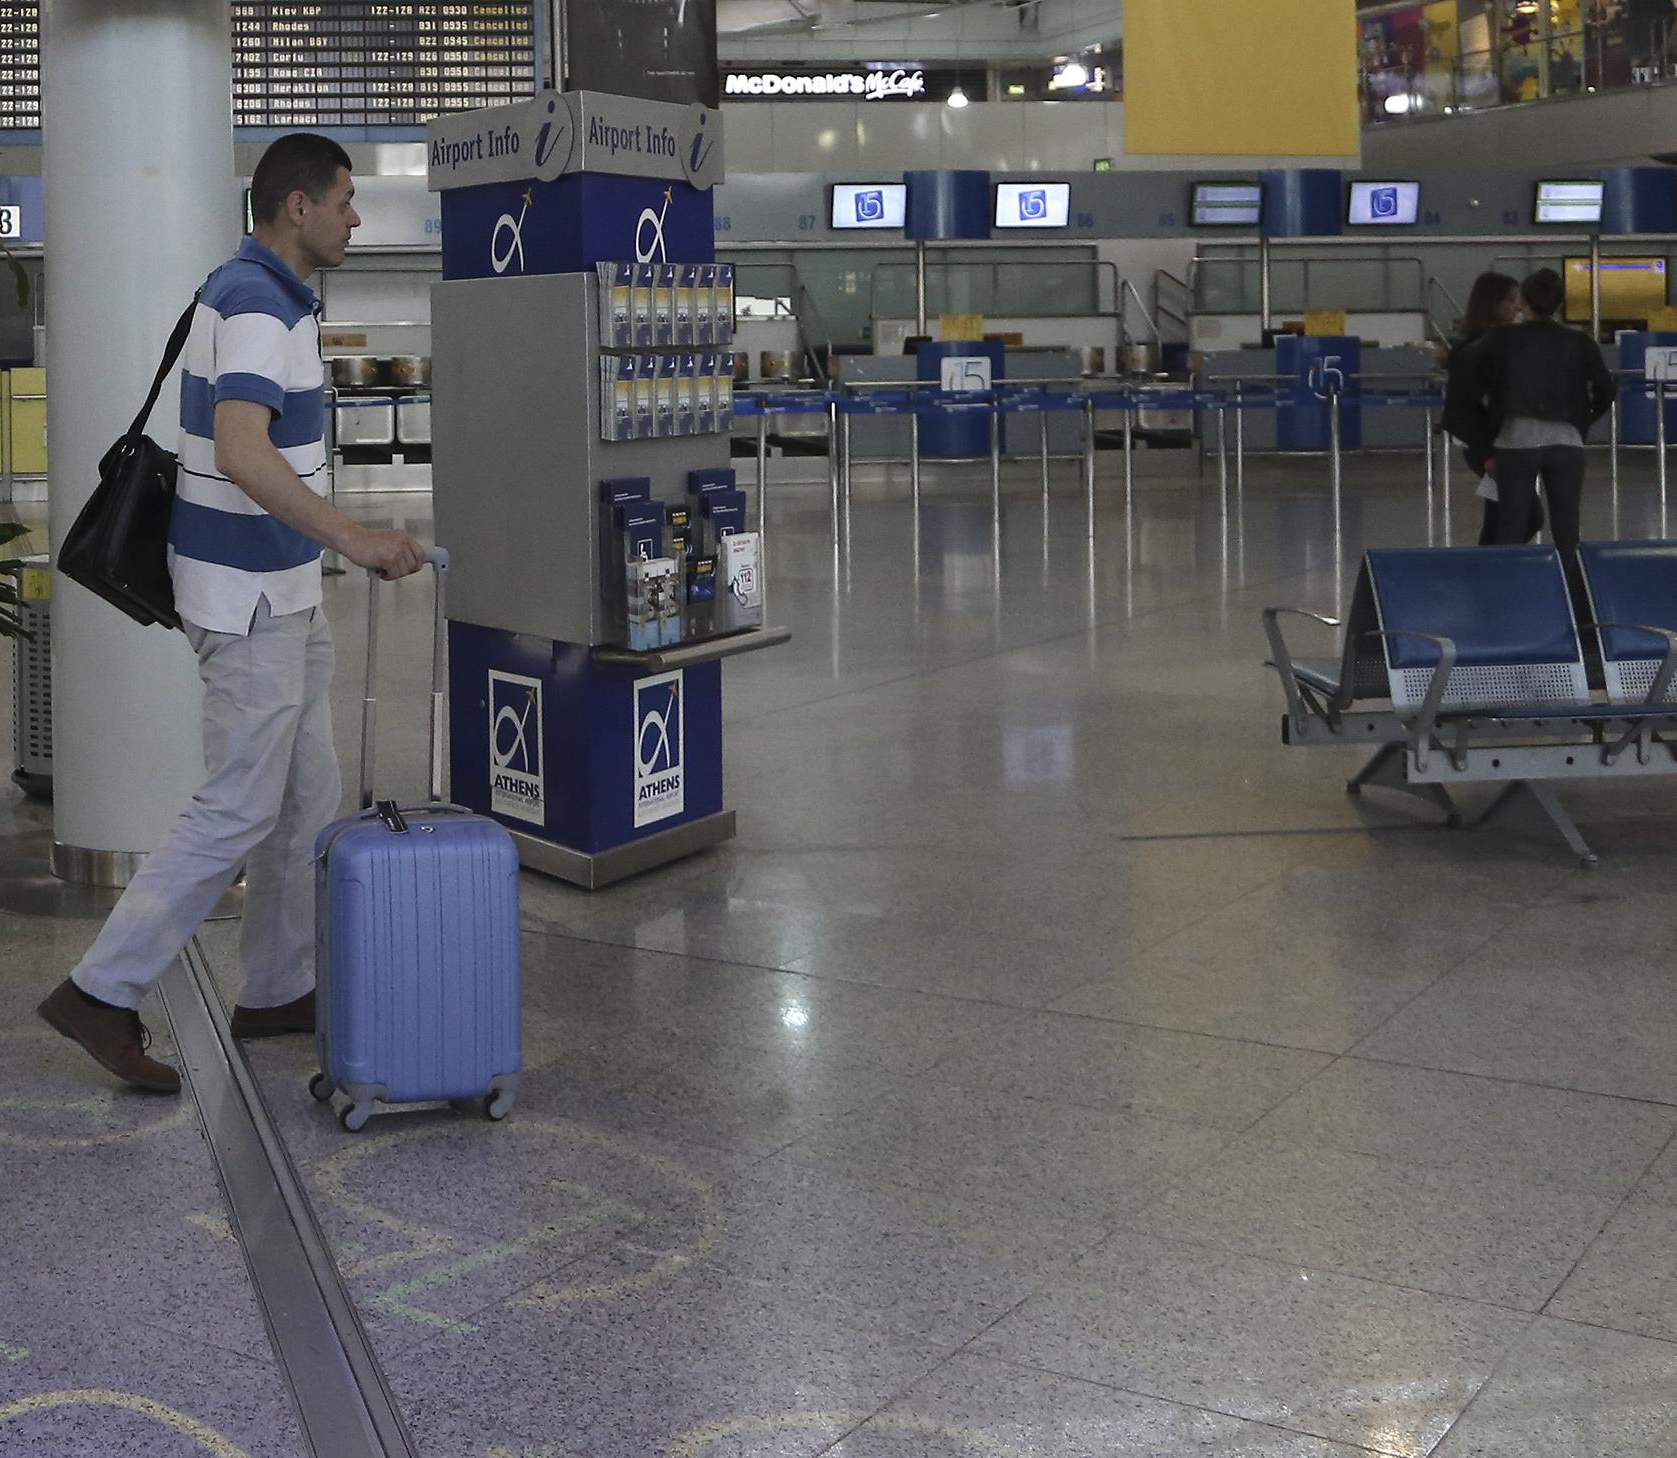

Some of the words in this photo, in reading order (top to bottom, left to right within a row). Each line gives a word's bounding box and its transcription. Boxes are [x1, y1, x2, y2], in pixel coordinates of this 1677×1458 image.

[272, 7, 297, 15] Kiev
[303, 6, 322, 15] KBP
[371, 6, 413, 15] 122-128
[443, 6, 468, 14] 0930
[473, 5, 528, 14] Cancelled
[236, 22, 261, 31] 1244
[272, 22, 310, 31] Rhodes
[443, 21, 468, 30] 0935
[473, 20, 528, 29] Cancelled
[273, 38, 304, 46] Milan
[443, 36, 468, 45] 0945
[474, 36, 529, 45] Cancelled
[235, 53, 261, 62] 7402
[273, 53, 304, 61] Corfu
[372, 52, 414, 61] 122-129
[444, 52, 468, 60] 0950
[474, 51, 529, 60] Cancelled
[273, 68, 298, 77] Rome
[444, 67, 469, 76] 0950
[273, 84, 329, 93] Heraklion
[372, 83, 414, 92] 122-128
[444, 82, 469, 91] 0955
[725, 74, 866, 94] McDonald's
[273, 99, 311, 108] Rhodes
[373, 98, 414, 107] 122-128
[444, 98, 469, 107] 0955
[274, 115, 317, 124] Larnaca
[589, 116, 641, 155] Airport
[646, 126, 676, 157] Info
[431, 137, 484, 170] Airport
[488, 126, 520, 156] Info
[739, 570, 753, 584] 112
[494, 774, 540, 799] ATHENS
[639, 774, 680, 800] ATHENS
